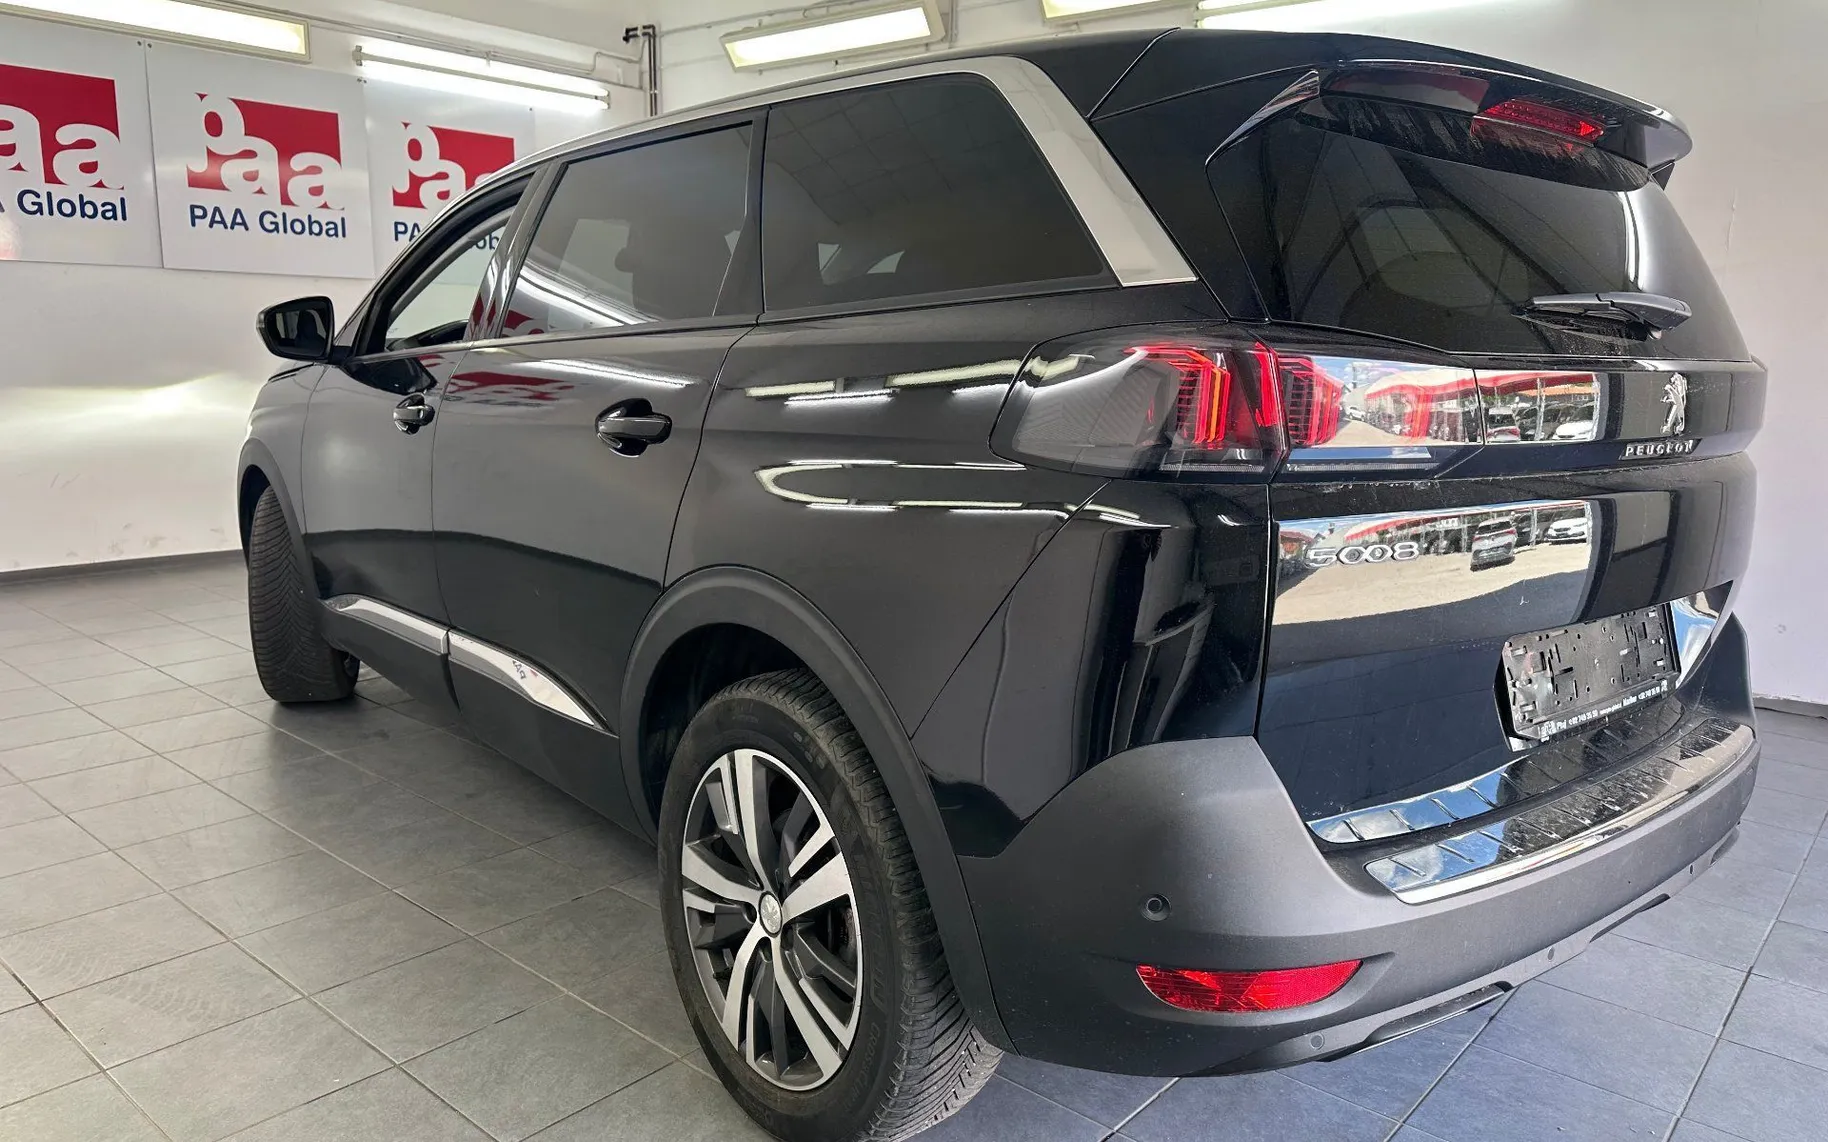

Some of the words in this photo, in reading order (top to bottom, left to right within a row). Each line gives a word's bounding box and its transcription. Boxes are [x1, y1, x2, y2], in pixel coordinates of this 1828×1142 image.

[392, 121, 496, 209] pa
[17, 189, 127, 221] Global
[189, 204, 249, 232] PAA
[259, 210, 346, 238] Global
[394, 221, 421, 241] PA
[1625, 439, 1694, 457] PEUGEOT
[1304, 541, 1419, 568] 5008
